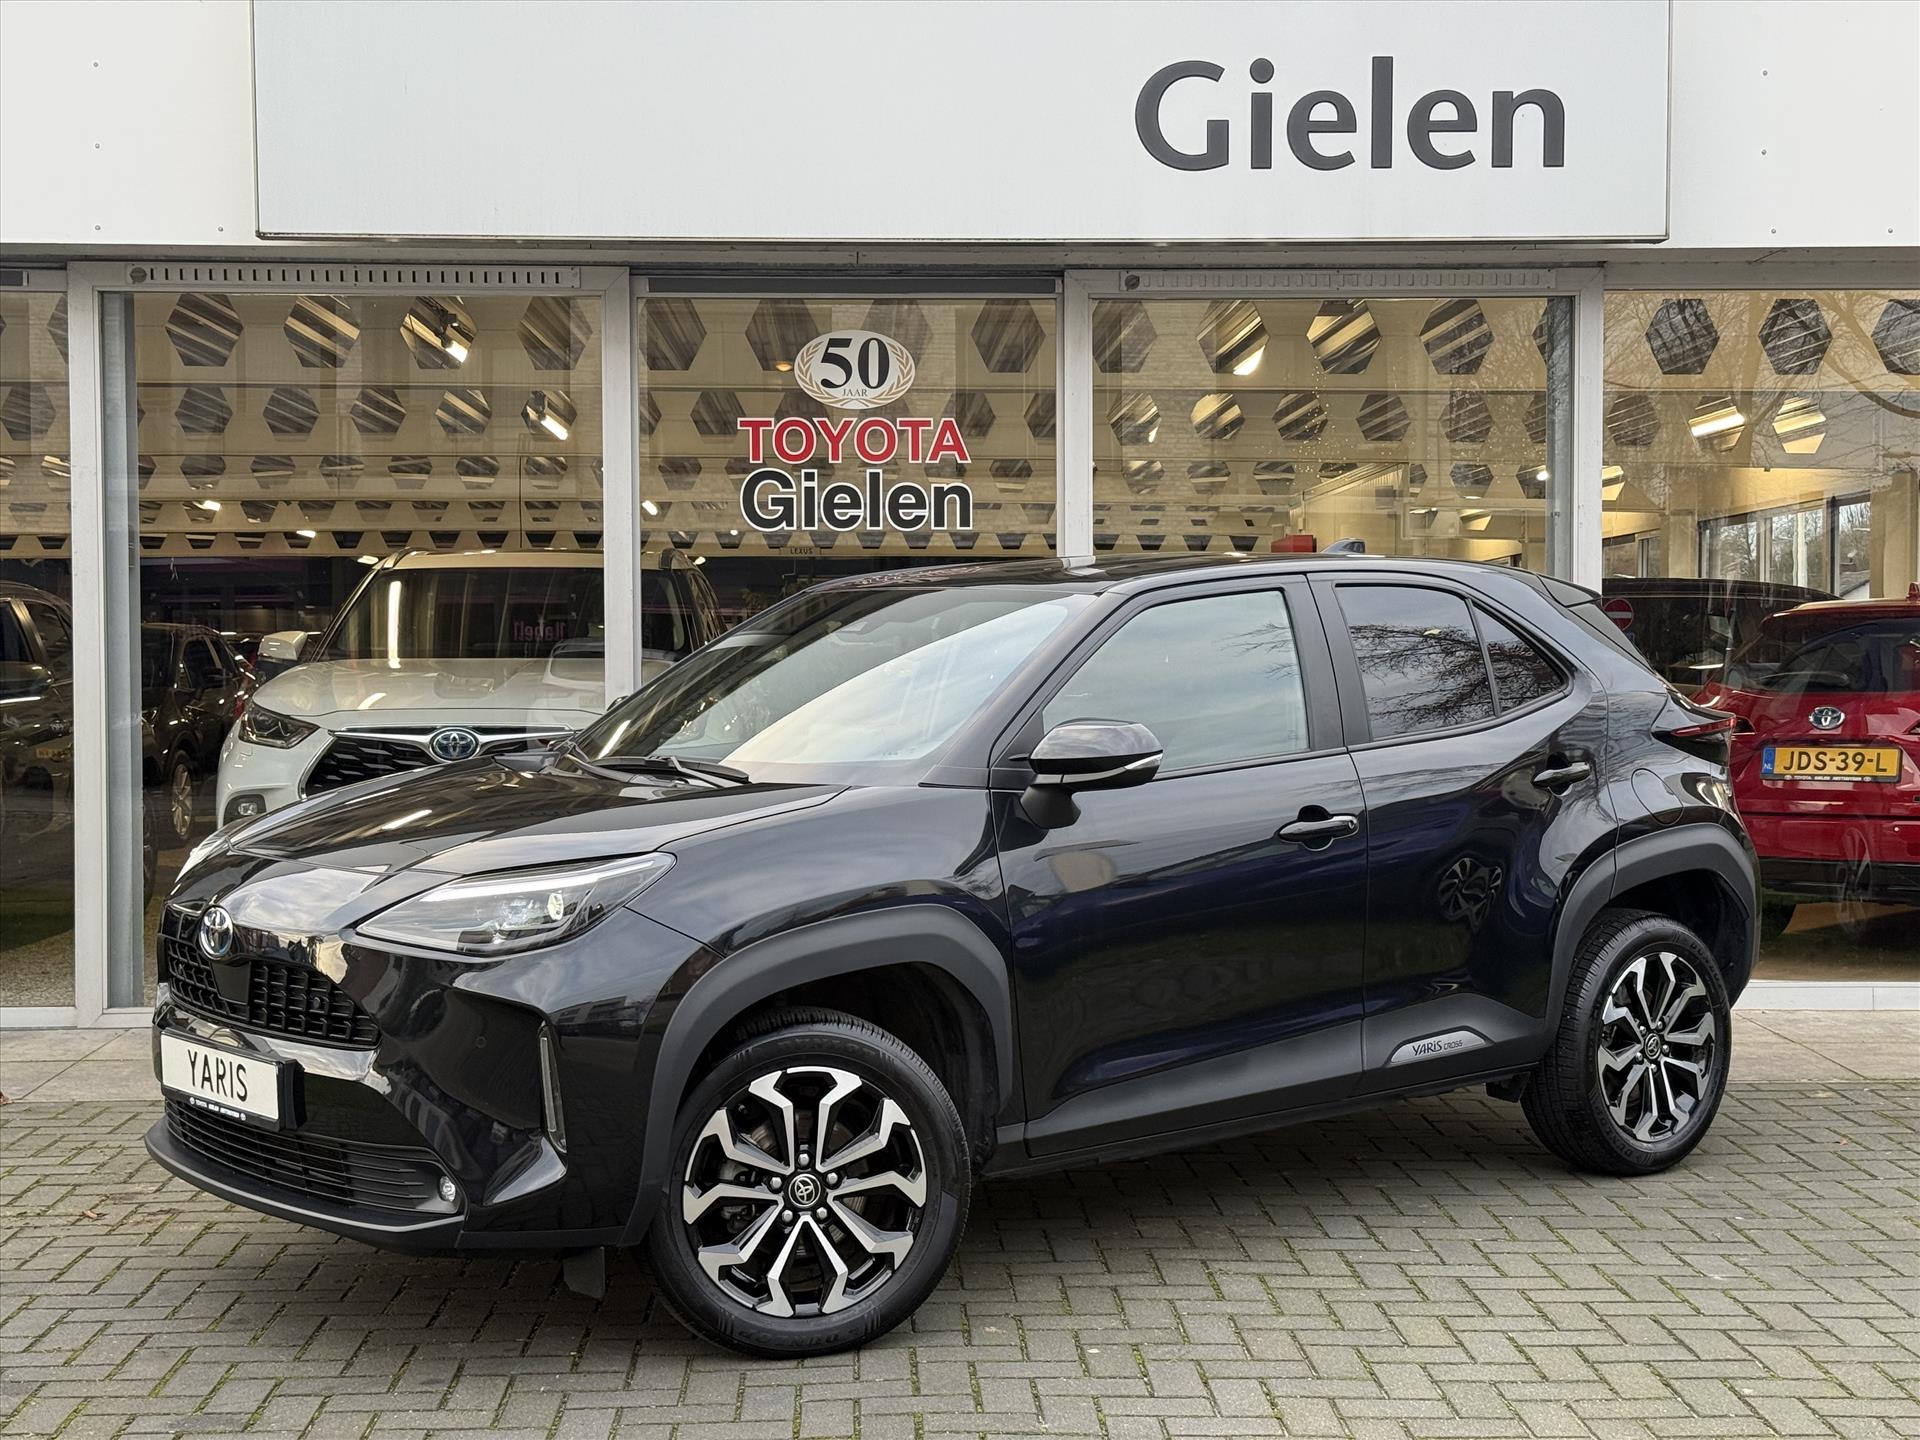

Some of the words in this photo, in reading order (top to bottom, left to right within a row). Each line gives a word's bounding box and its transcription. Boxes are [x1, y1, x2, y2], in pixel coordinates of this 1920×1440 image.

[1135, 56, 1565, 171] Gielen
[820, 338, 890, 389] 50
[841, 389, 868, 397] JAAR
[737, 417, 971, 464] TOYOTA
[740, 468, 973, 531] Gielen
[1783, 751, 1888, 773] JDS-39-L
[187, 1049, 248, 1102] YARIS
